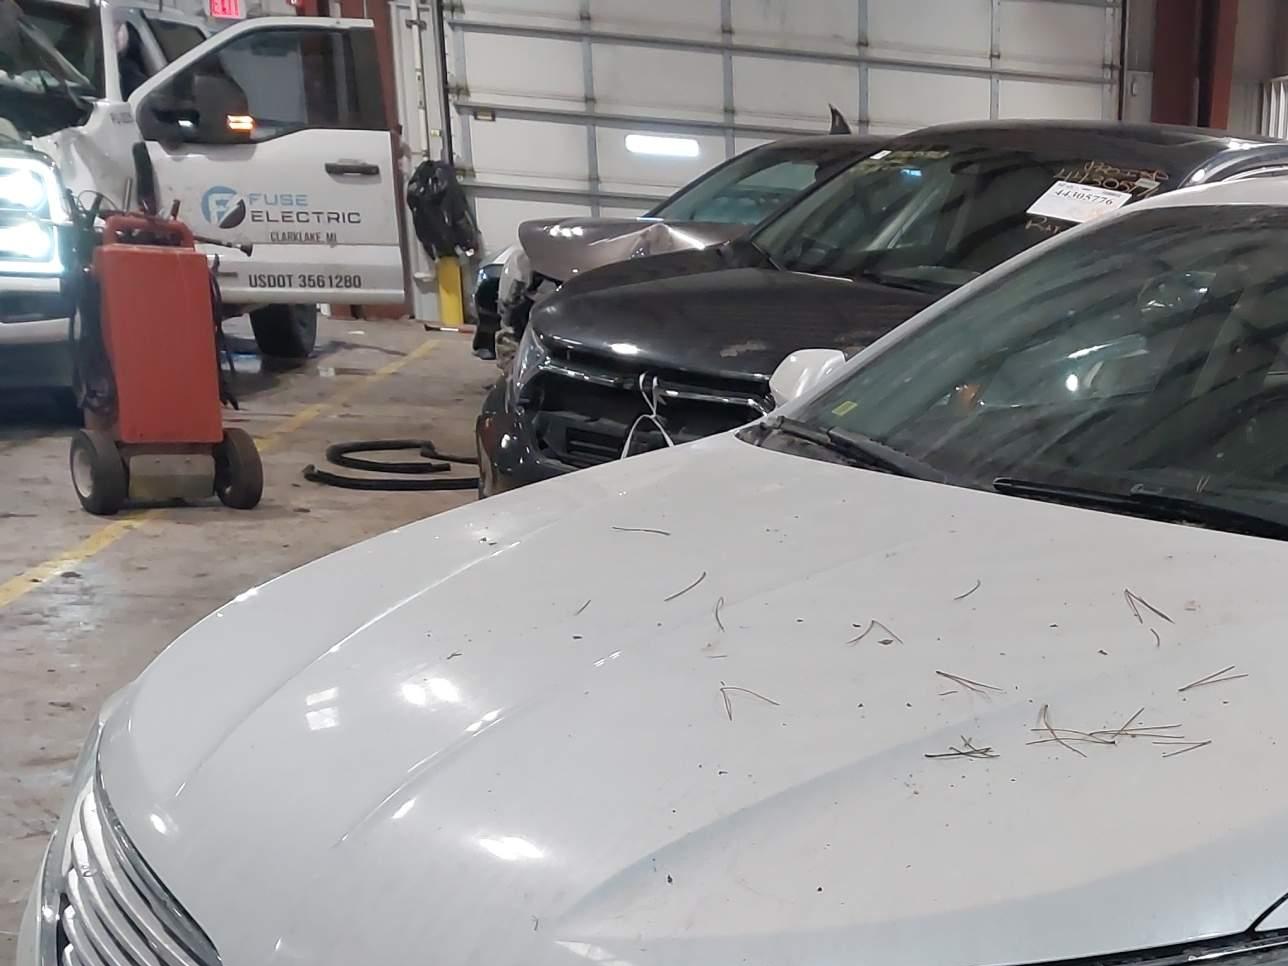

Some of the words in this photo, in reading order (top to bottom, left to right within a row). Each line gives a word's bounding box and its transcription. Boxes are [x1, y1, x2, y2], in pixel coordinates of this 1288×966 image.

[248, 193, 308, 206] FUSE
[1054, 190, 1113, 206] 44305776
[251, 210, 361, 224] ELECTRIC
[249, 274, 294, 288] USDOT
[298, 274, 362, 288] 3561280
